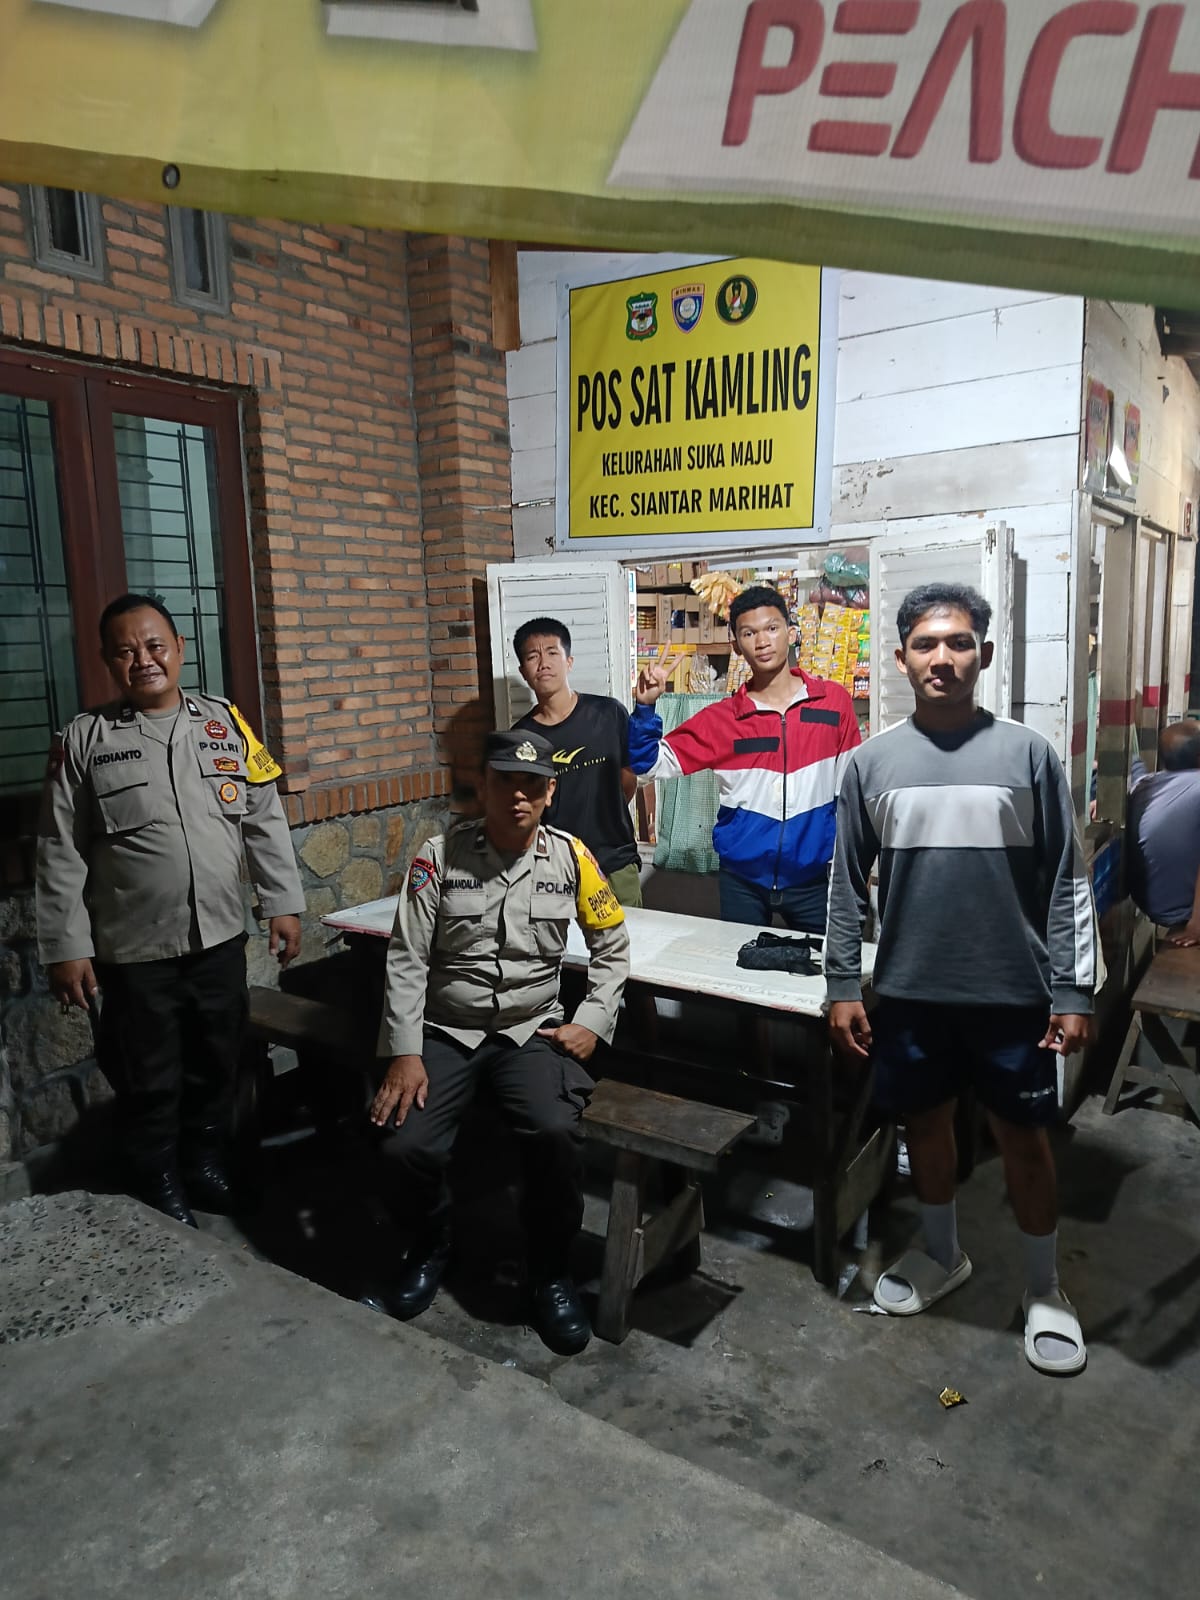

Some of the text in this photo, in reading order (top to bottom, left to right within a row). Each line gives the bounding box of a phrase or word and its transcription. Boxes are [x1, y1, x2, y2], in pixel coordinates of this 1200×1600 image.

[577, 343, 812, 432] POS SAT KAMLING
[602, 438, 773, 477] KELURAHAN SUKA MAJU
[590, 483, 795, 518] KEC. SIANTAR MARIHAT
[199, 741, 239, 753] POLRI
[536, 881, 577, 896] POLRI
